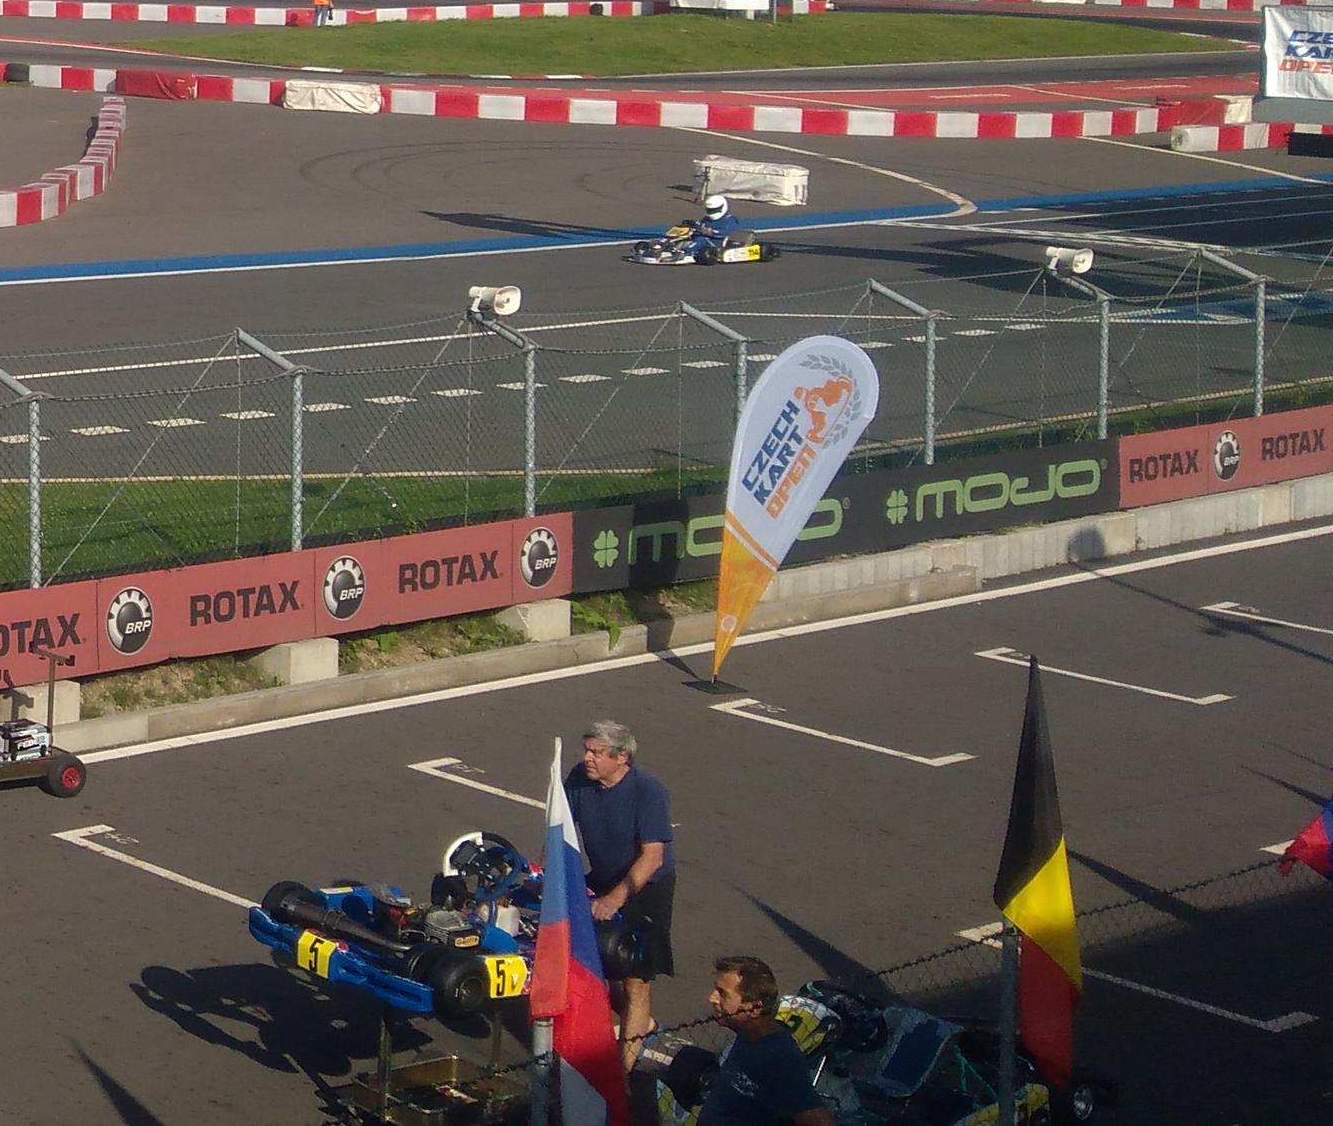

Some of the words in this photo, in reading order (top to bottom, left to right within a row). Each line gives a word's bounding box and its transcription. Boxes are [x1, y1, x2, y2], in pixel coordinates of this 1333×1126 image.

[742, 400, 800, 491] CZECH
[1261, 428, 1325, 461] ROTAX
[753, 425, 805, 506] KART
[766, 443, 818, 519] OPEN
[1129, 450, 1199, 484] ROTAX
[398, 550, 499, 594] ROTAX
[534, 556, 556, 570] BRP
[190, 580, 300, 627] ROTAX
[339, 586, 365, 601] BRP
[124, 619, 151, 634] BRP
[307, 943, 321, 973] 5
[495, 959, 506, 996] 5
